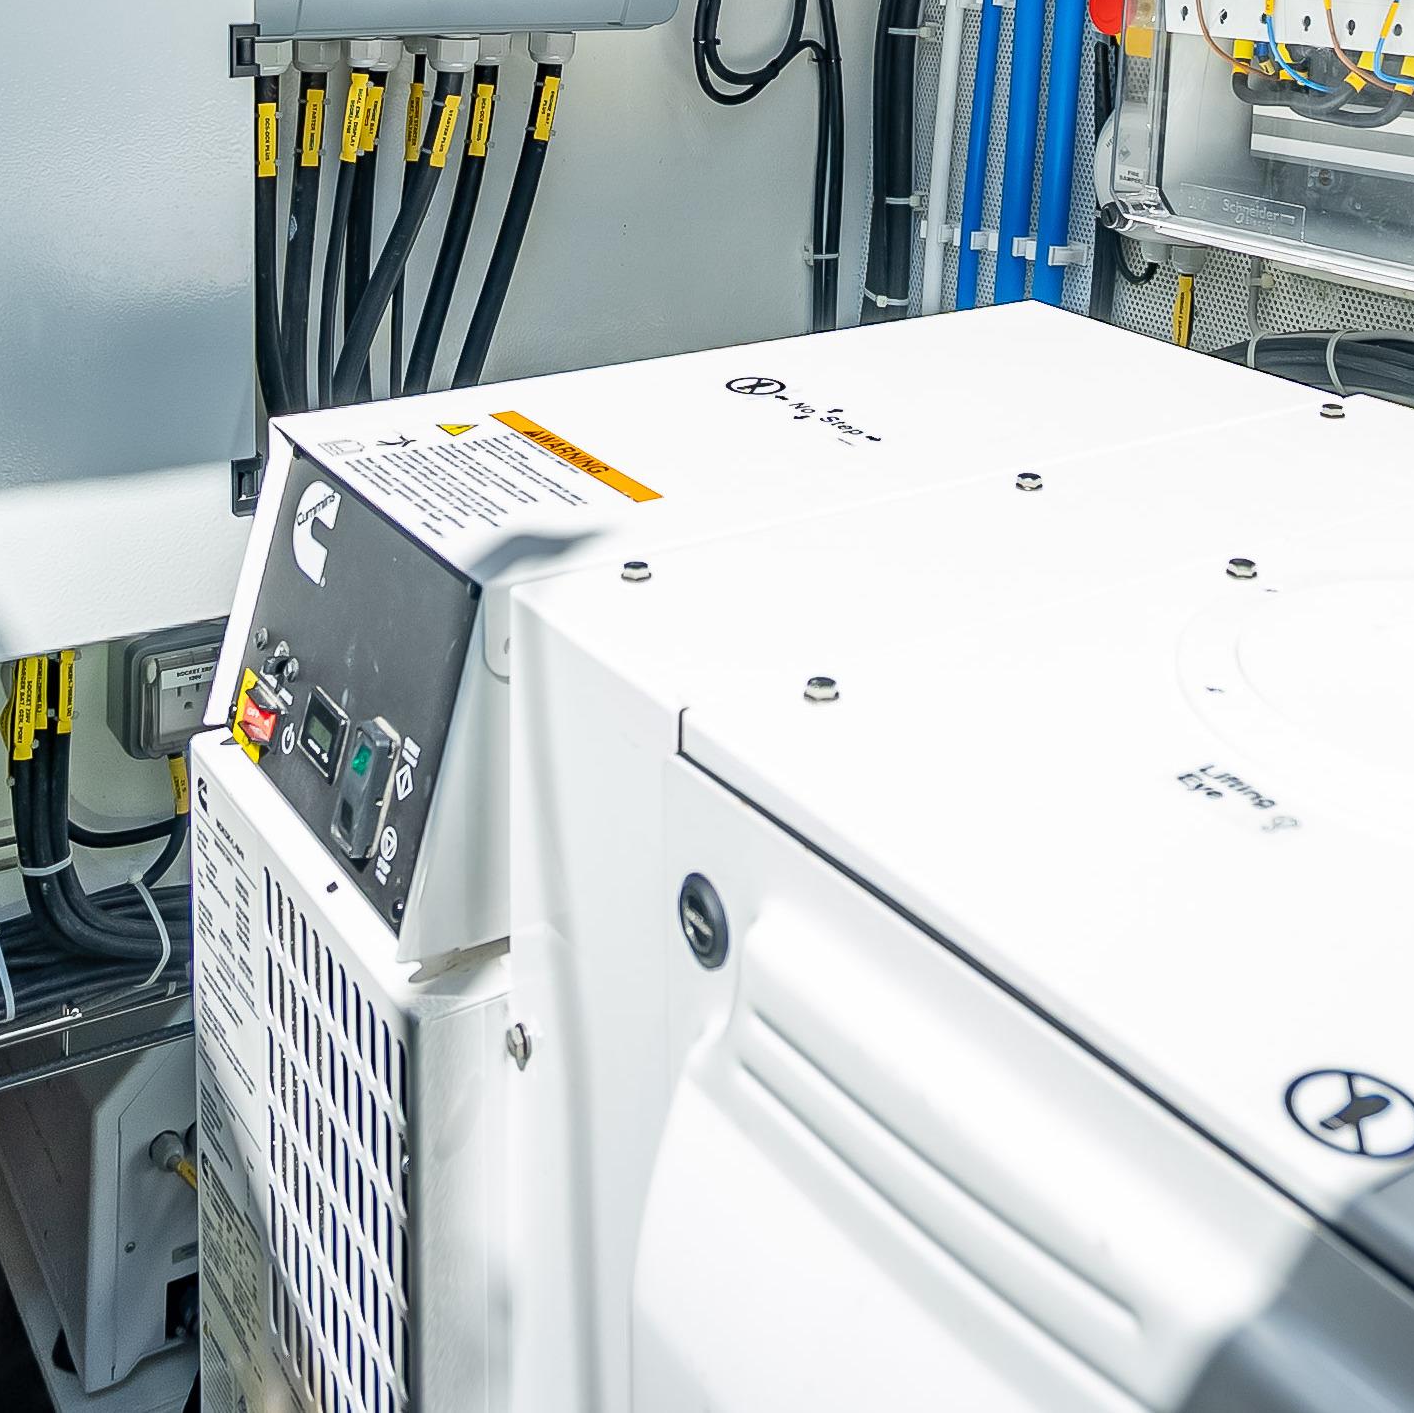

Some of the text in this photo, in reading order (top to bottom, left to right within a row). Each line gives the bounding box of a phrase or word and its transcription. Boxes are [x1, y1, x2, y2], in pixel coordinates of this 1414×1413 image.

[1222, 198, 1280, 222] Schneider
[789, 402, 864, 435] No Step
[531, 433, 609, 476] WARNING
[296, 490, 337, 527] Cummins
[1177, 773, 1223, 797] Eye
[1199, 764, 1276, 808] Lifting
